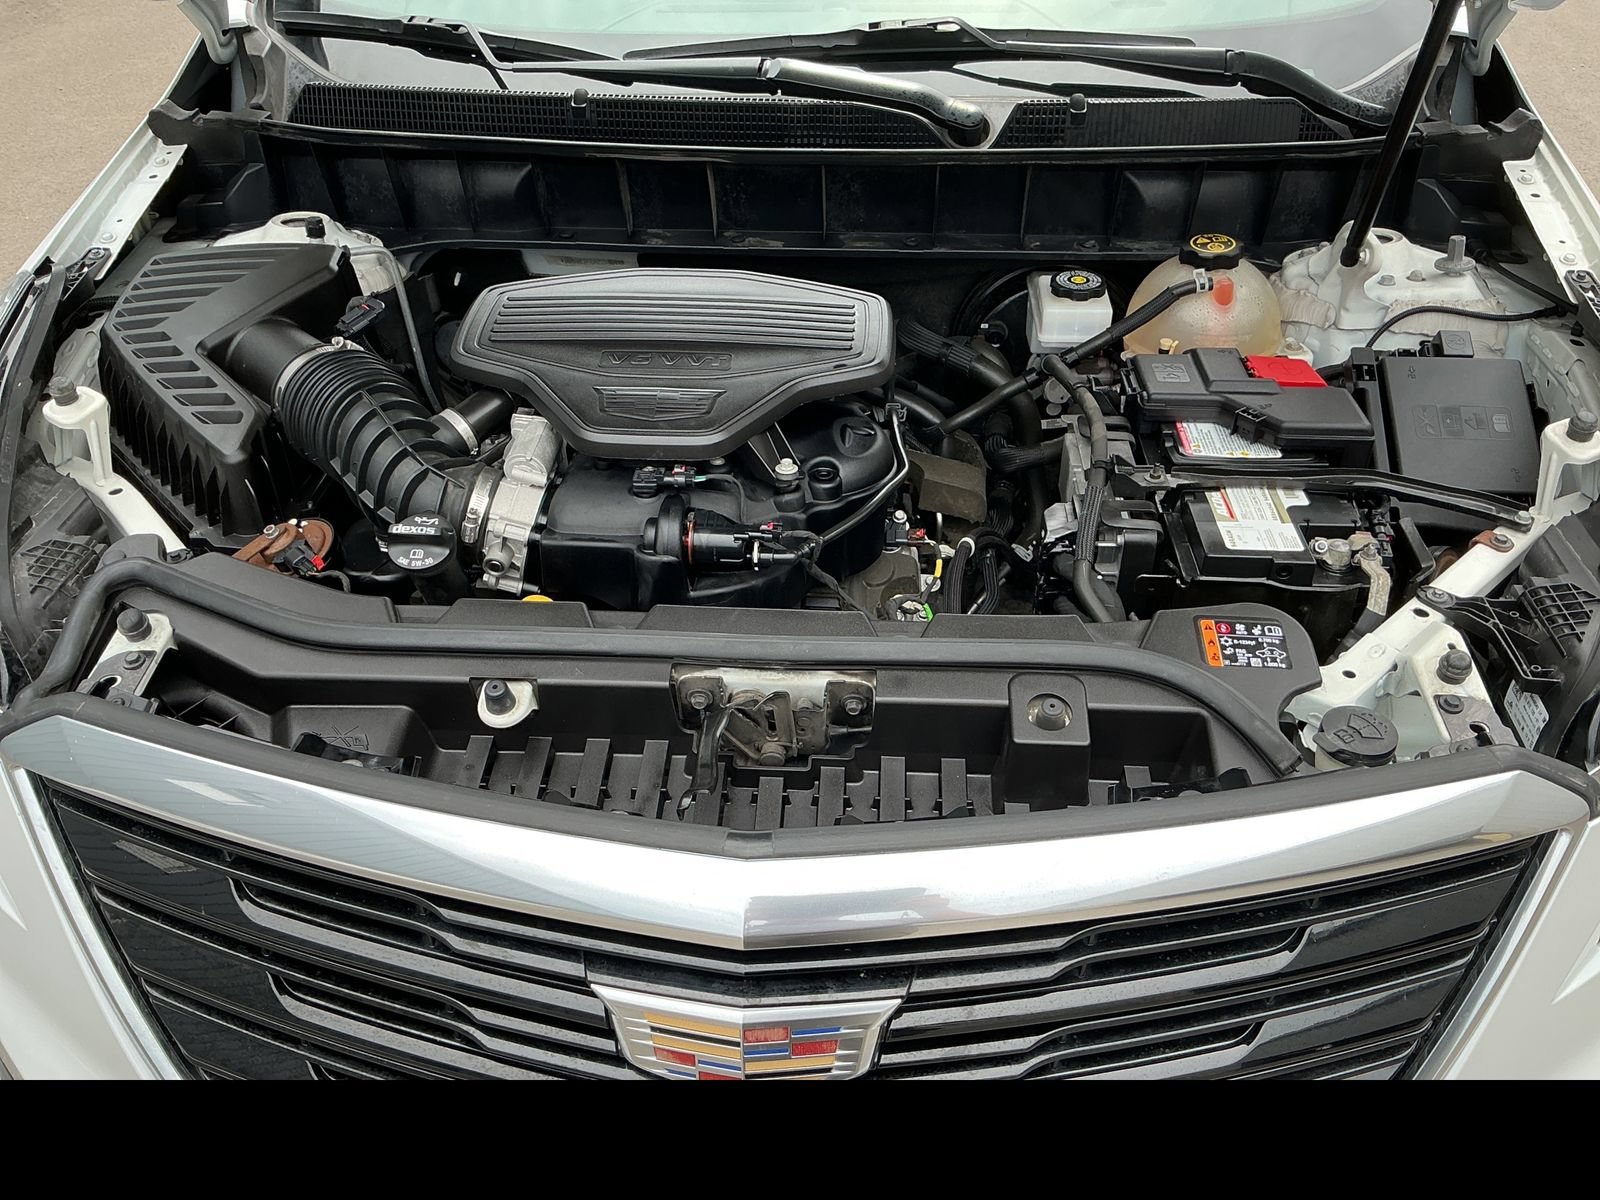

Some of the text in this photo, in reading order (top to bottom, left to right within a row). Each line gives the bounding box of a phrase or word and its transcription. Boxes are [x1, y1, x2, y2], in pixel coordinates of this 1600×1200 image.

[607, 352, 652, 365] V6
[392, 523, 436, 535] dexos
[397, 556, 434, 567] SAE 5W-30
